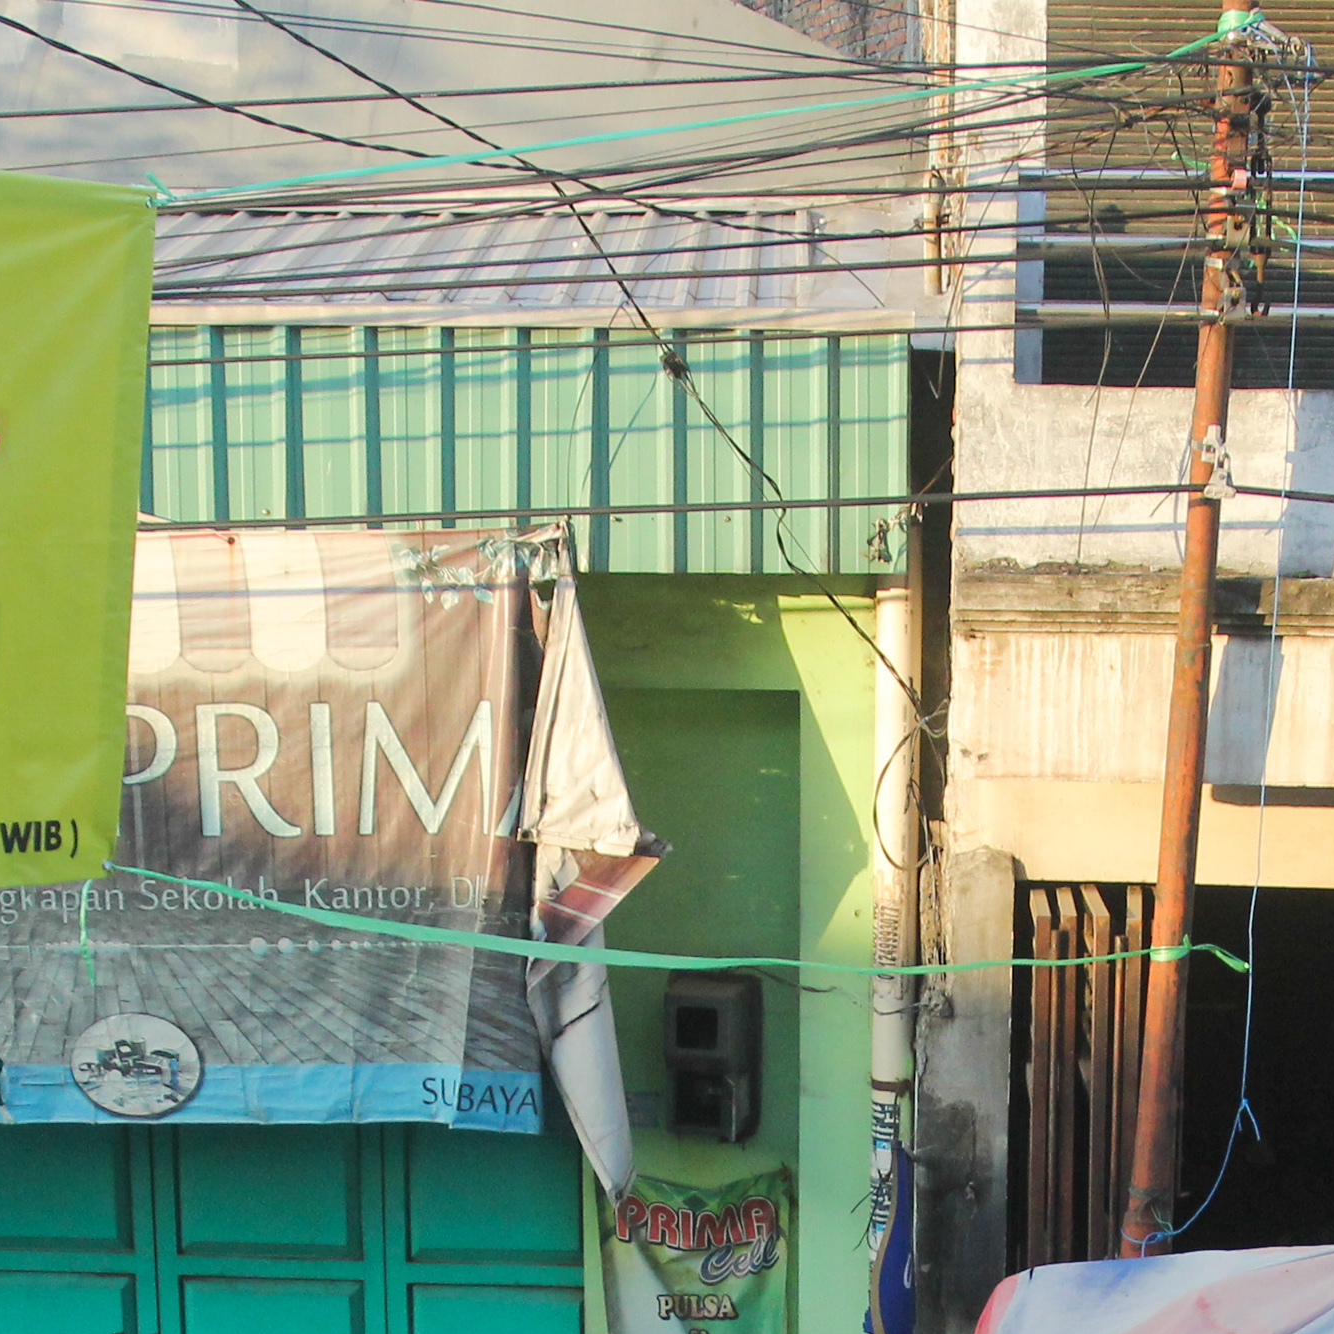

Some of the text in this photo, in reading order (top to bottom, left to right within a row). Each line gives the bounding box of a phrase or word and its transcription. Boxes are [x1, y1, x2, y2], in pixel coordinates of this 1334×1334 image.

[615, 1193, 780, 1251] PRIMA
[698, 1233, 780, 1286] Cell
[657, 1294, 740, 1321] PULSA
